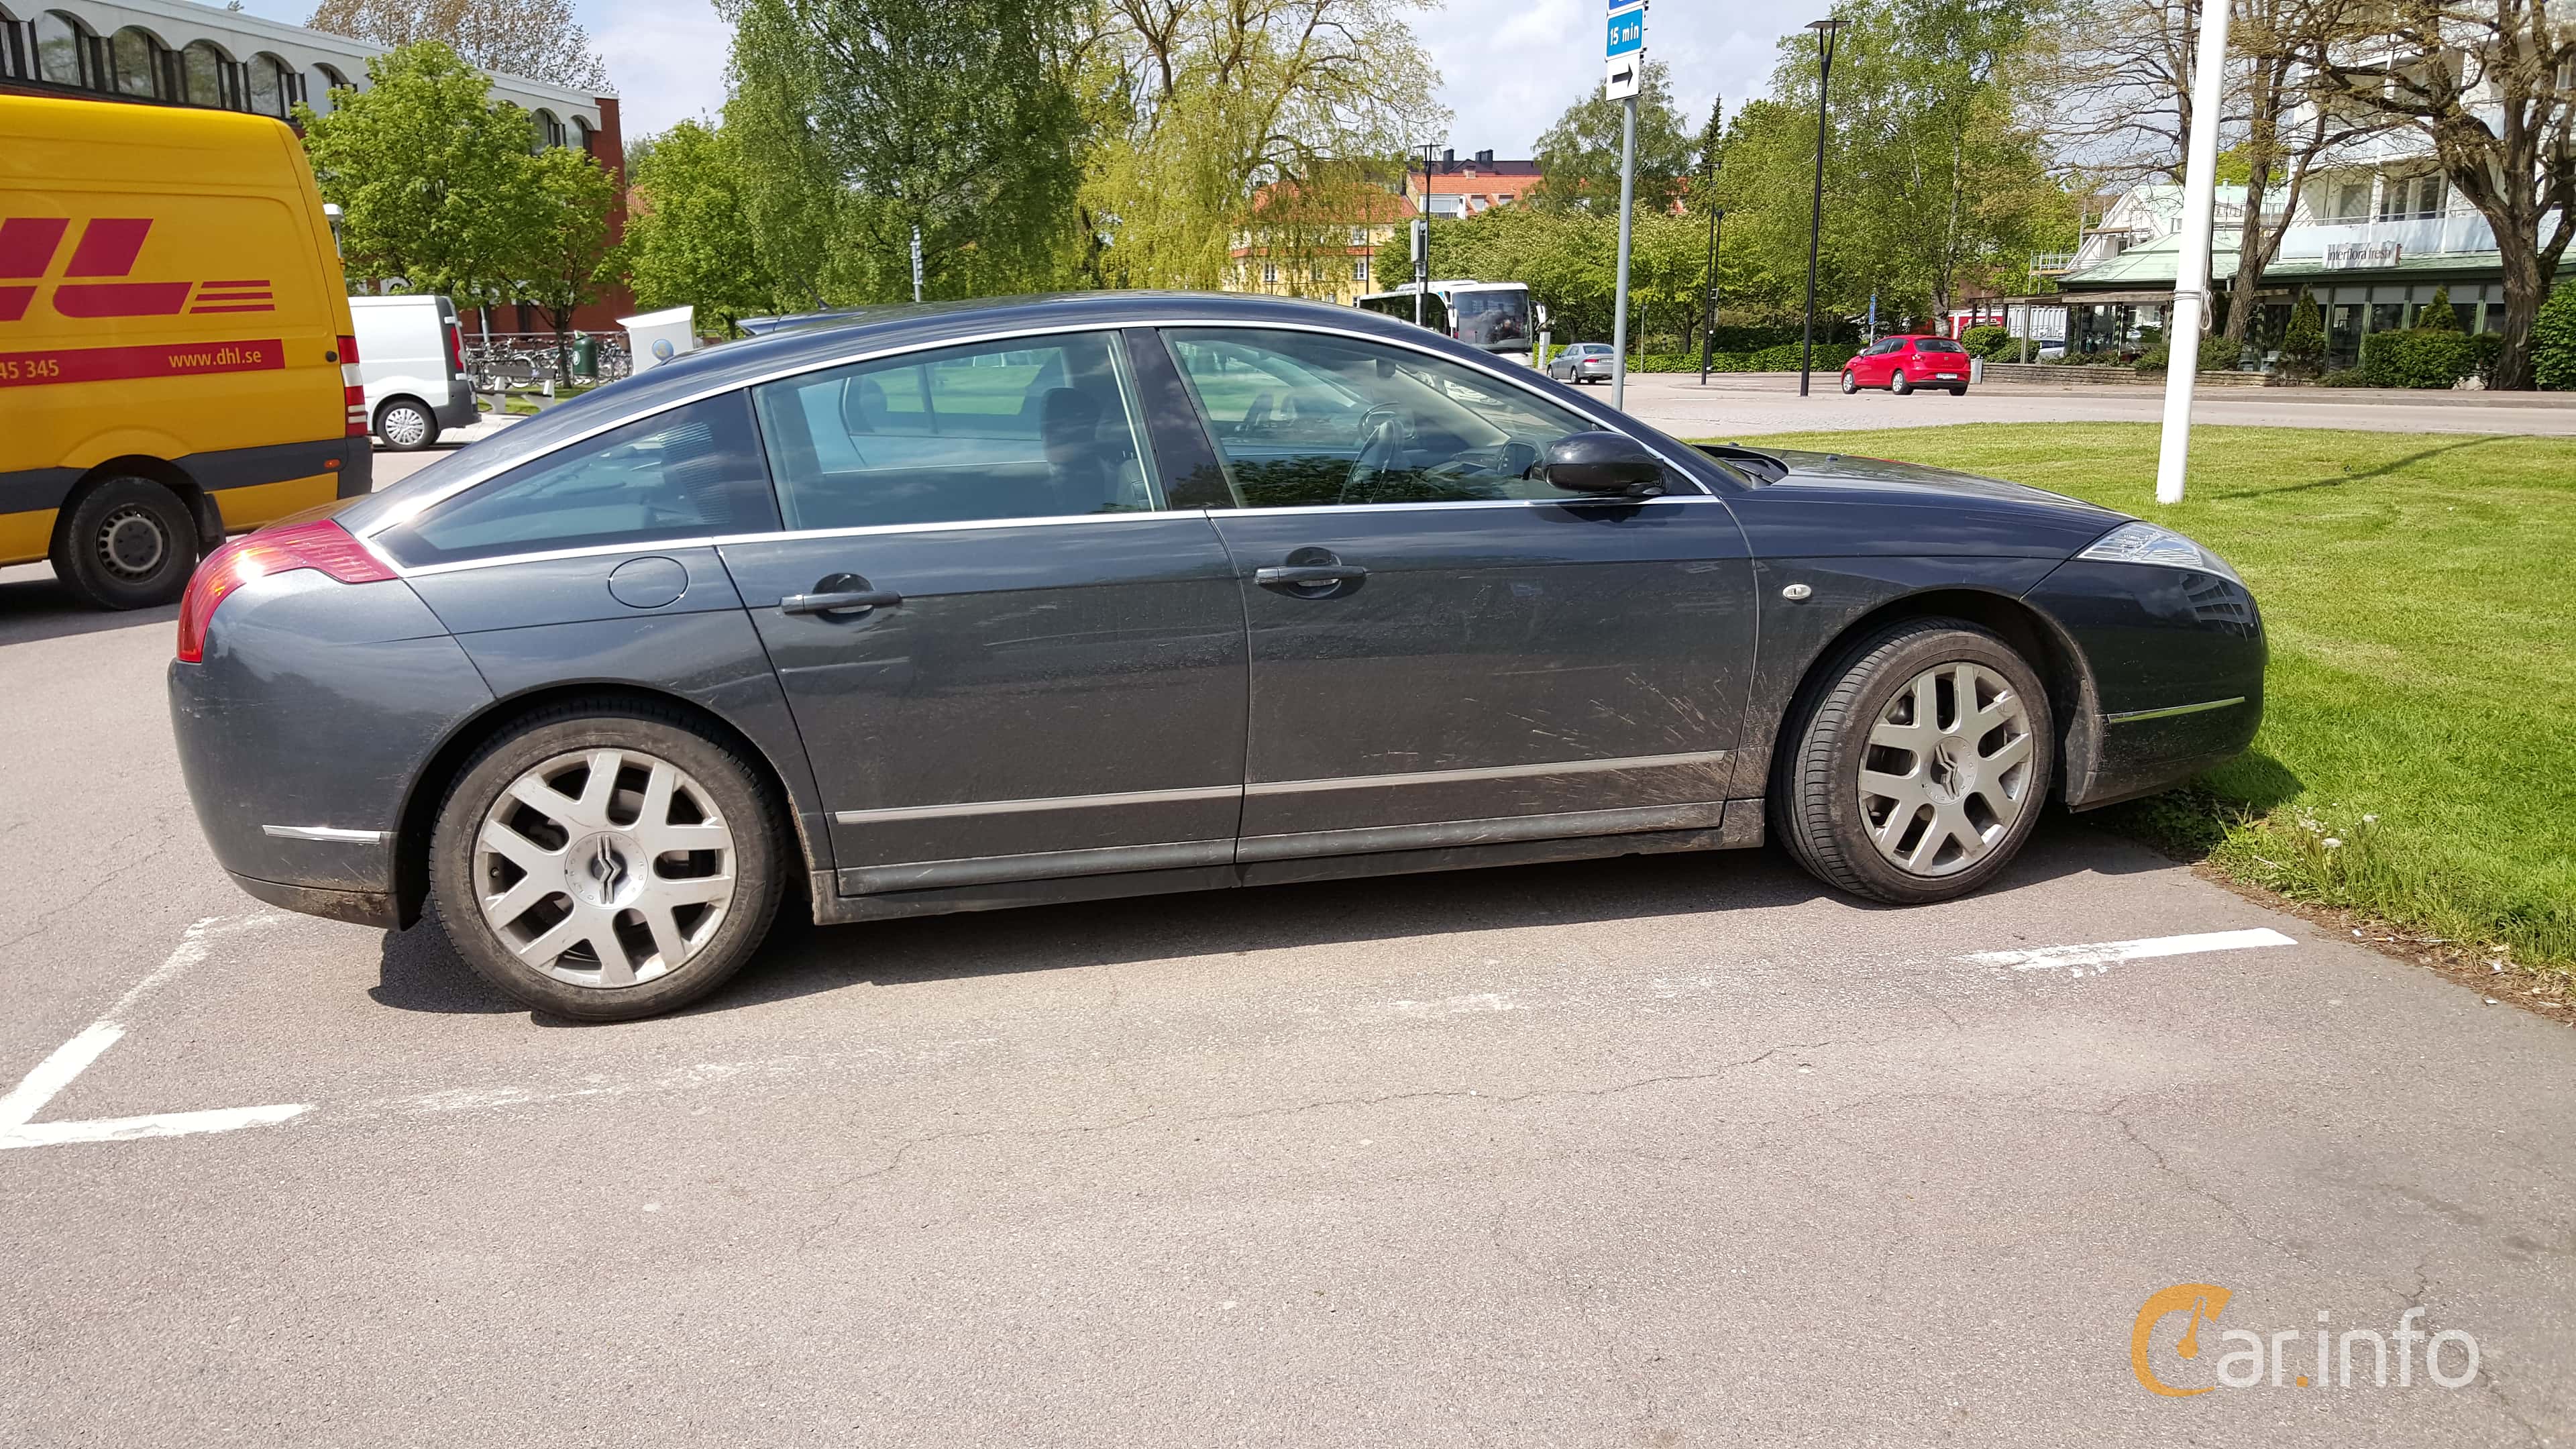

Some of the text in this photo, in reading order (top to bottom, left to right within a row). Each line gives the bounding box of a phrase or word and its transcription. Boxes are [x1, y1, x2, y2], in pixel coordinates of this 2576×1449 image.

[1610, 22, 1639, 46] 15 min
[2328, 247, 2391, 260] interflora fresh
[168, 347, 262, 368] www.dhl.se
[25, 360, 59, 378] 345
